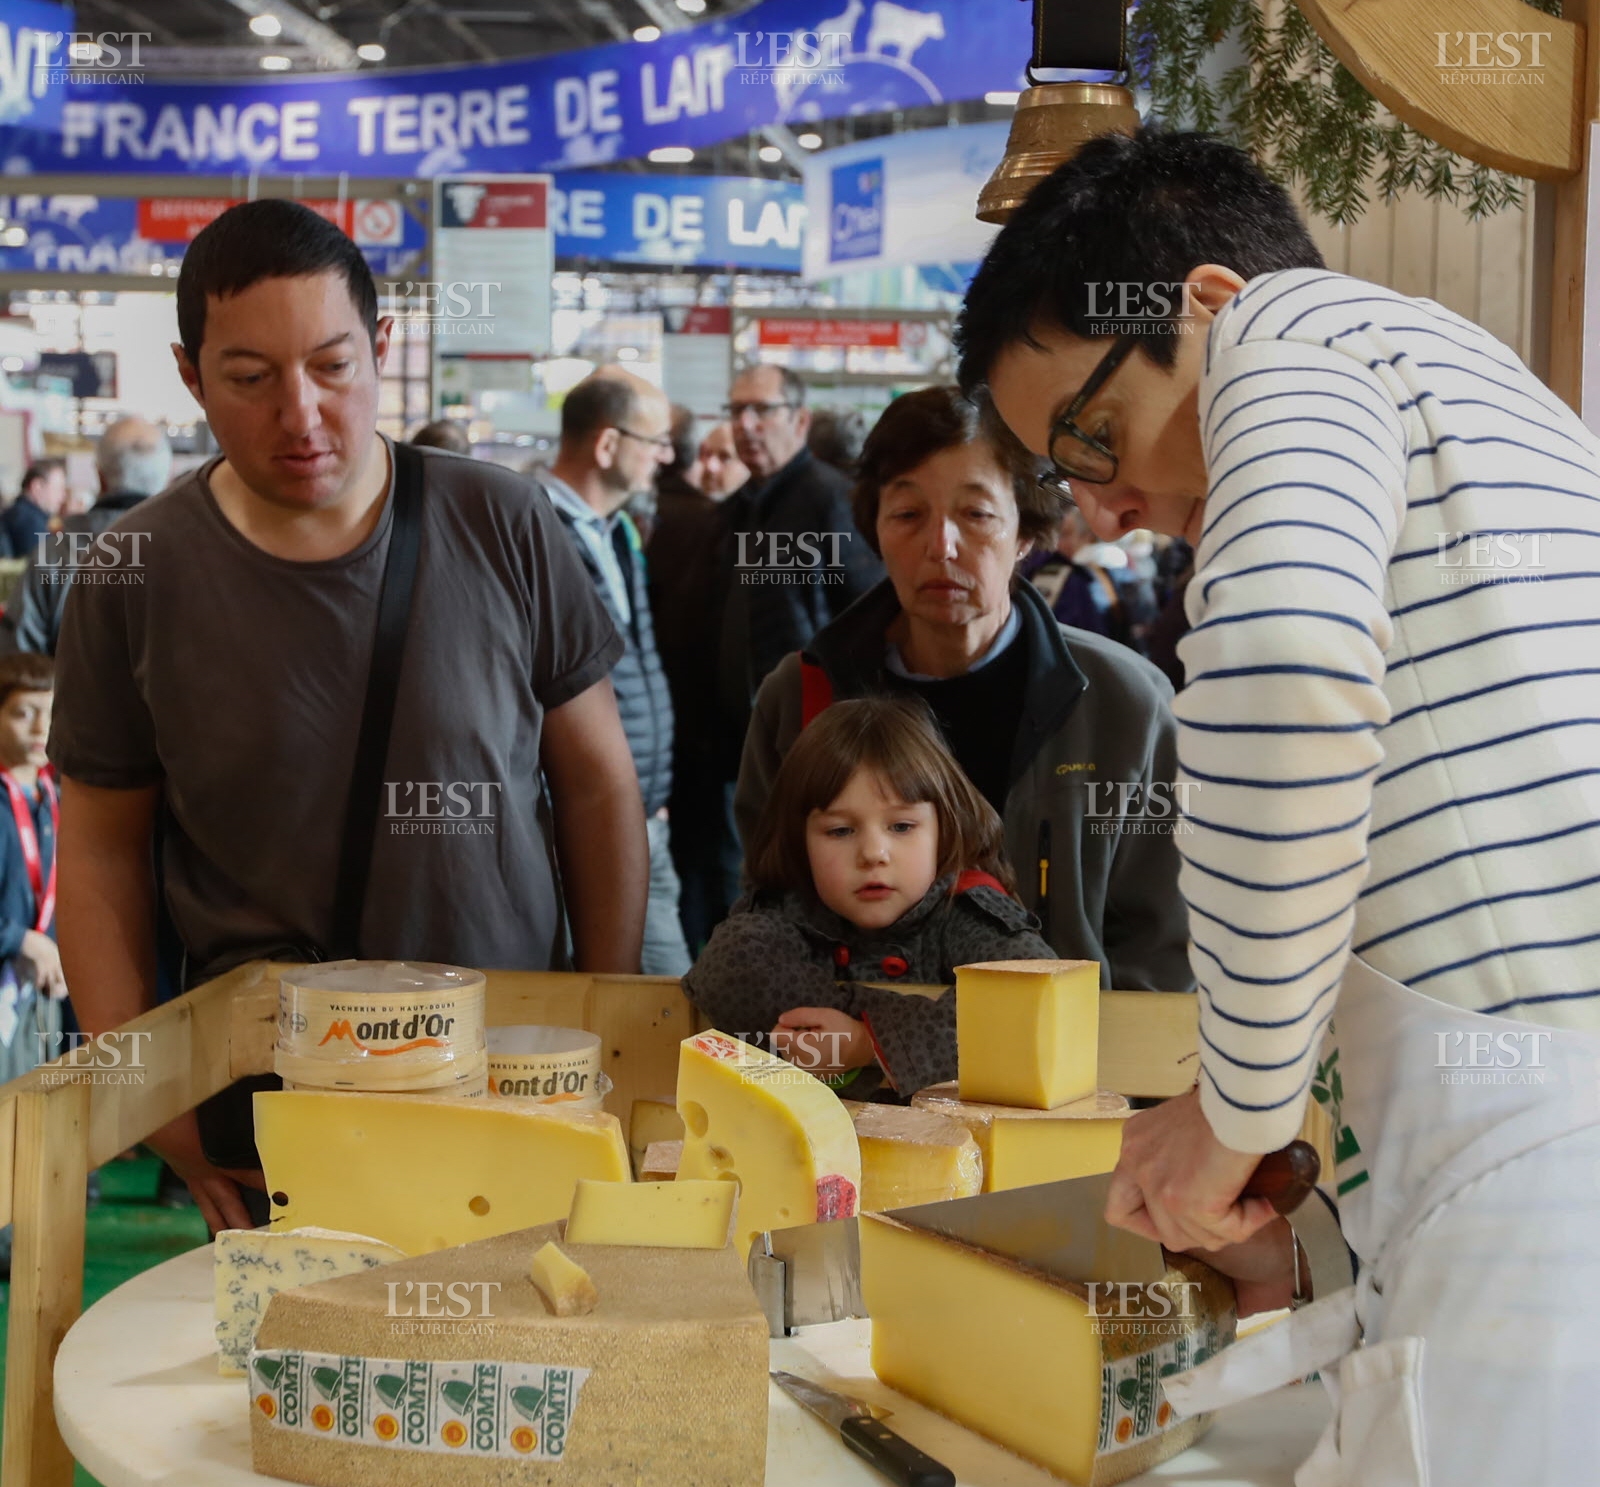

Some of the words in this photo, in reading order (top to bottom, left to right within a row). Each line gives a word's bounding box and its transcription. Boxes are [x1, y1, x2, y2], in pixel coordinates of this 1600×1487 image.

[62, 101, 320, 161] FRANCE
[347, 86, 530, 156] TERRE
[555, 70, 623, 138] DE
[640, 44, 735, 125] LAIT
[632, 193, 705, 242] DE
[330, 1004, 376, 1012] VACHERIN
[318, 1018, 399, 1046] Mont
[402, 1013, 455, 1040] d'Or
[489, 1062, 518, 1070] HERIN
[542, 1070, 588, 1096] d'Or
